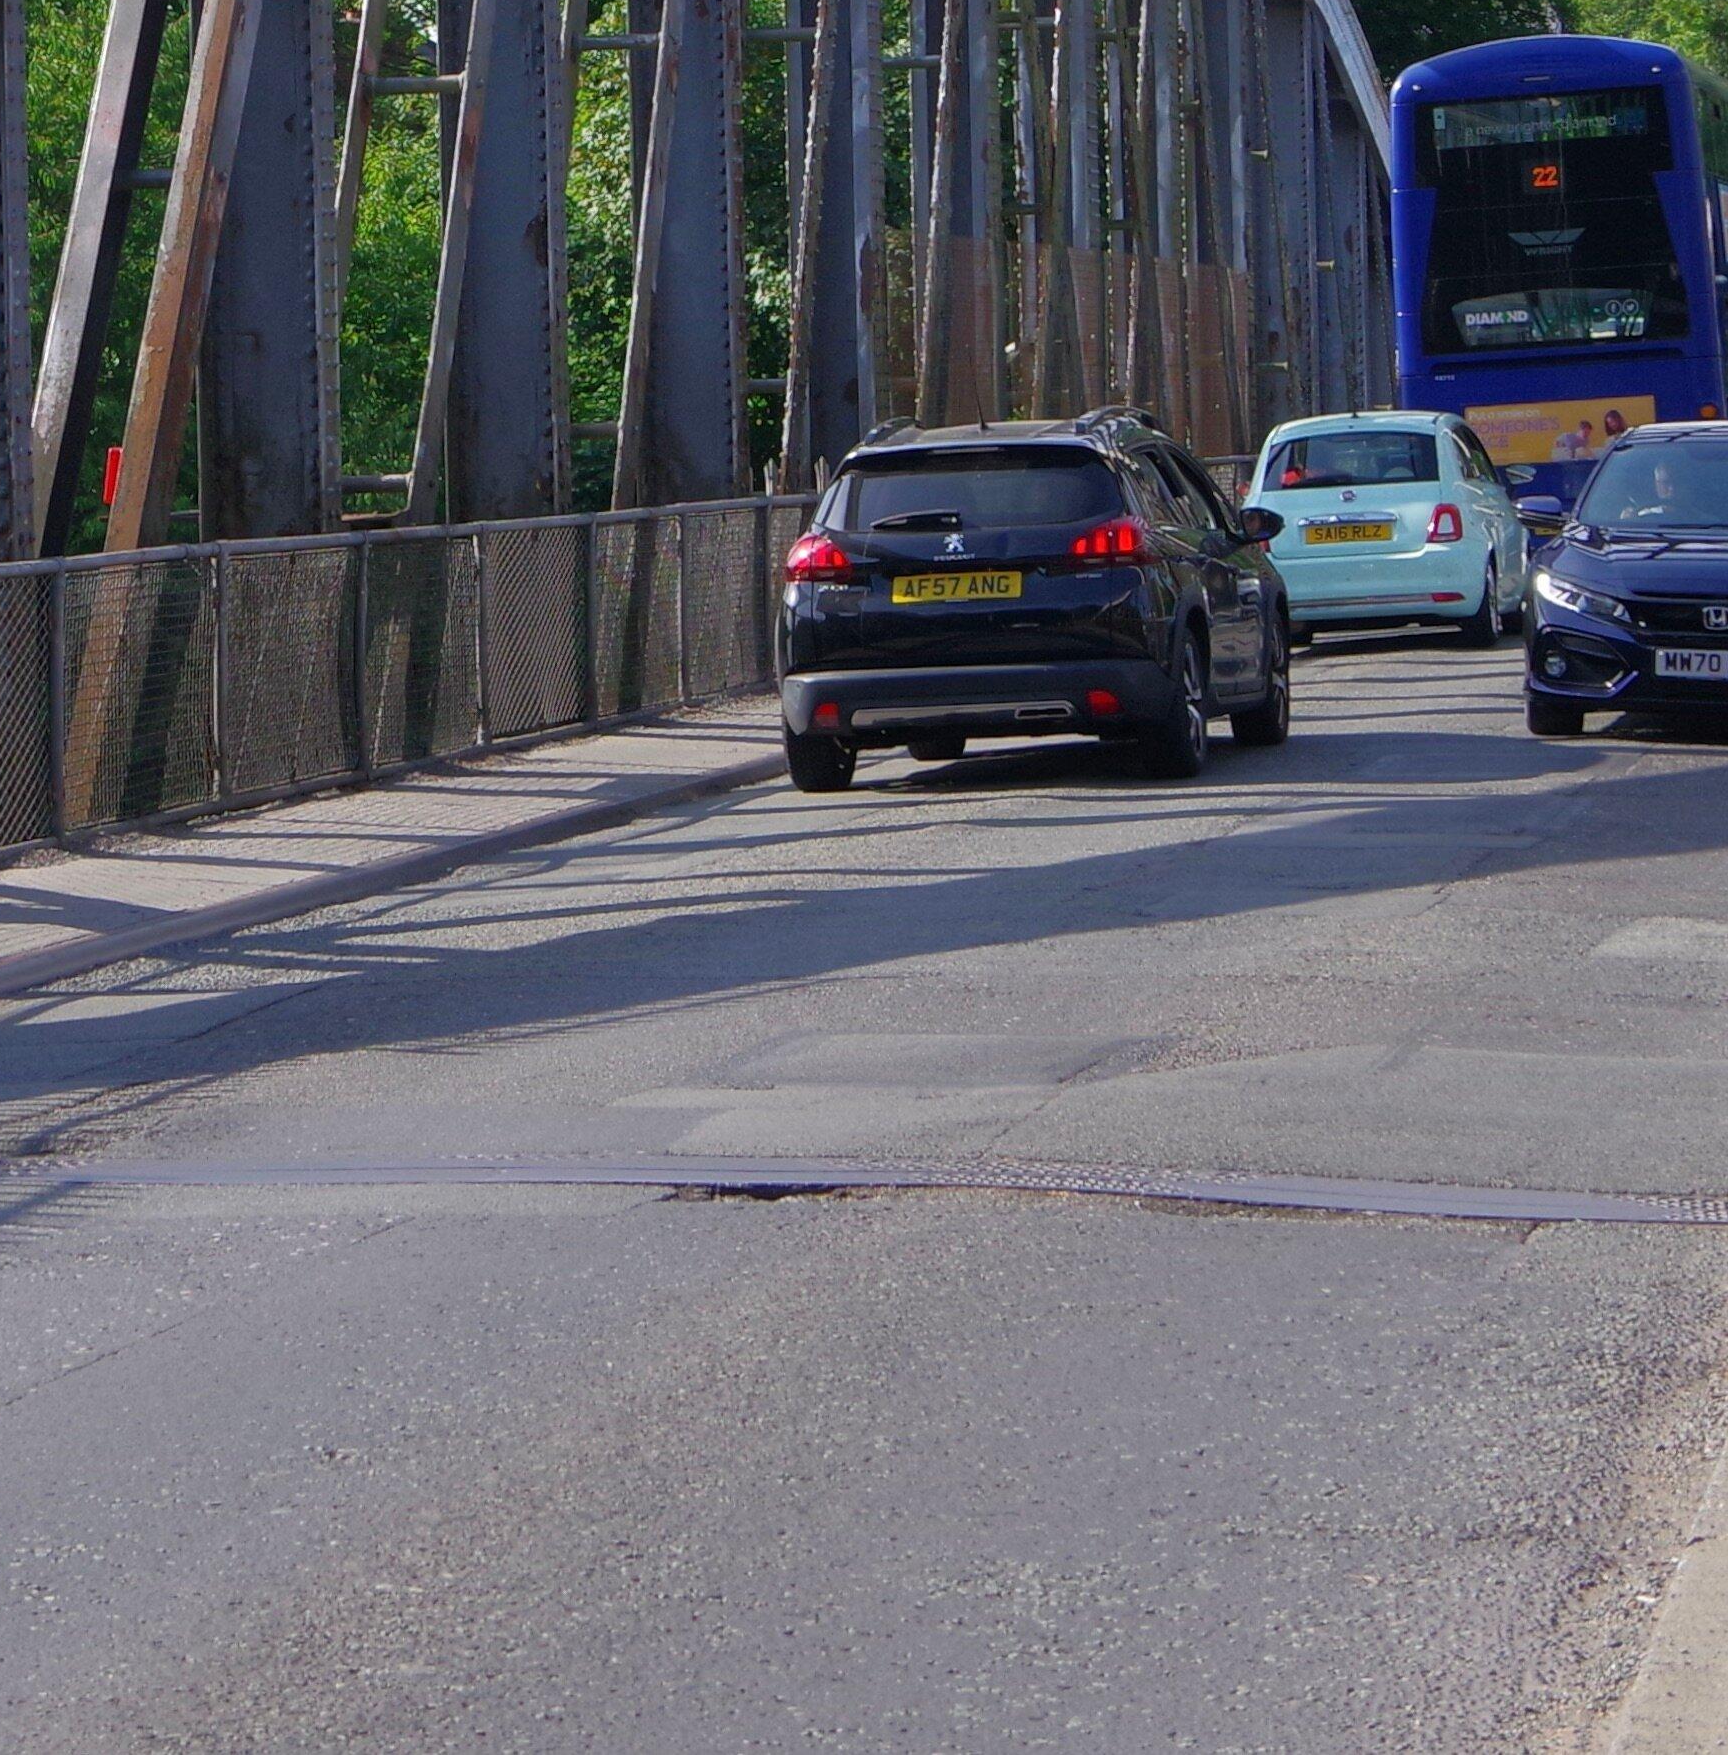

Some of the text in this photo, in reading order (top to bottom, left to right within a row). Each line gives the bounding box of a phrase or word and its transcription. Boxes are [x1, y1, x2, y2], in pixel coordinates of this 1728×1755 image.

[1531, 165, 1559, 187] 22
[1314, 525, 1382, 541] SA16 RLZ
[904, 575, 1010, 598] AF57 ANG
[1664, 652, 1722, 673] MW70
